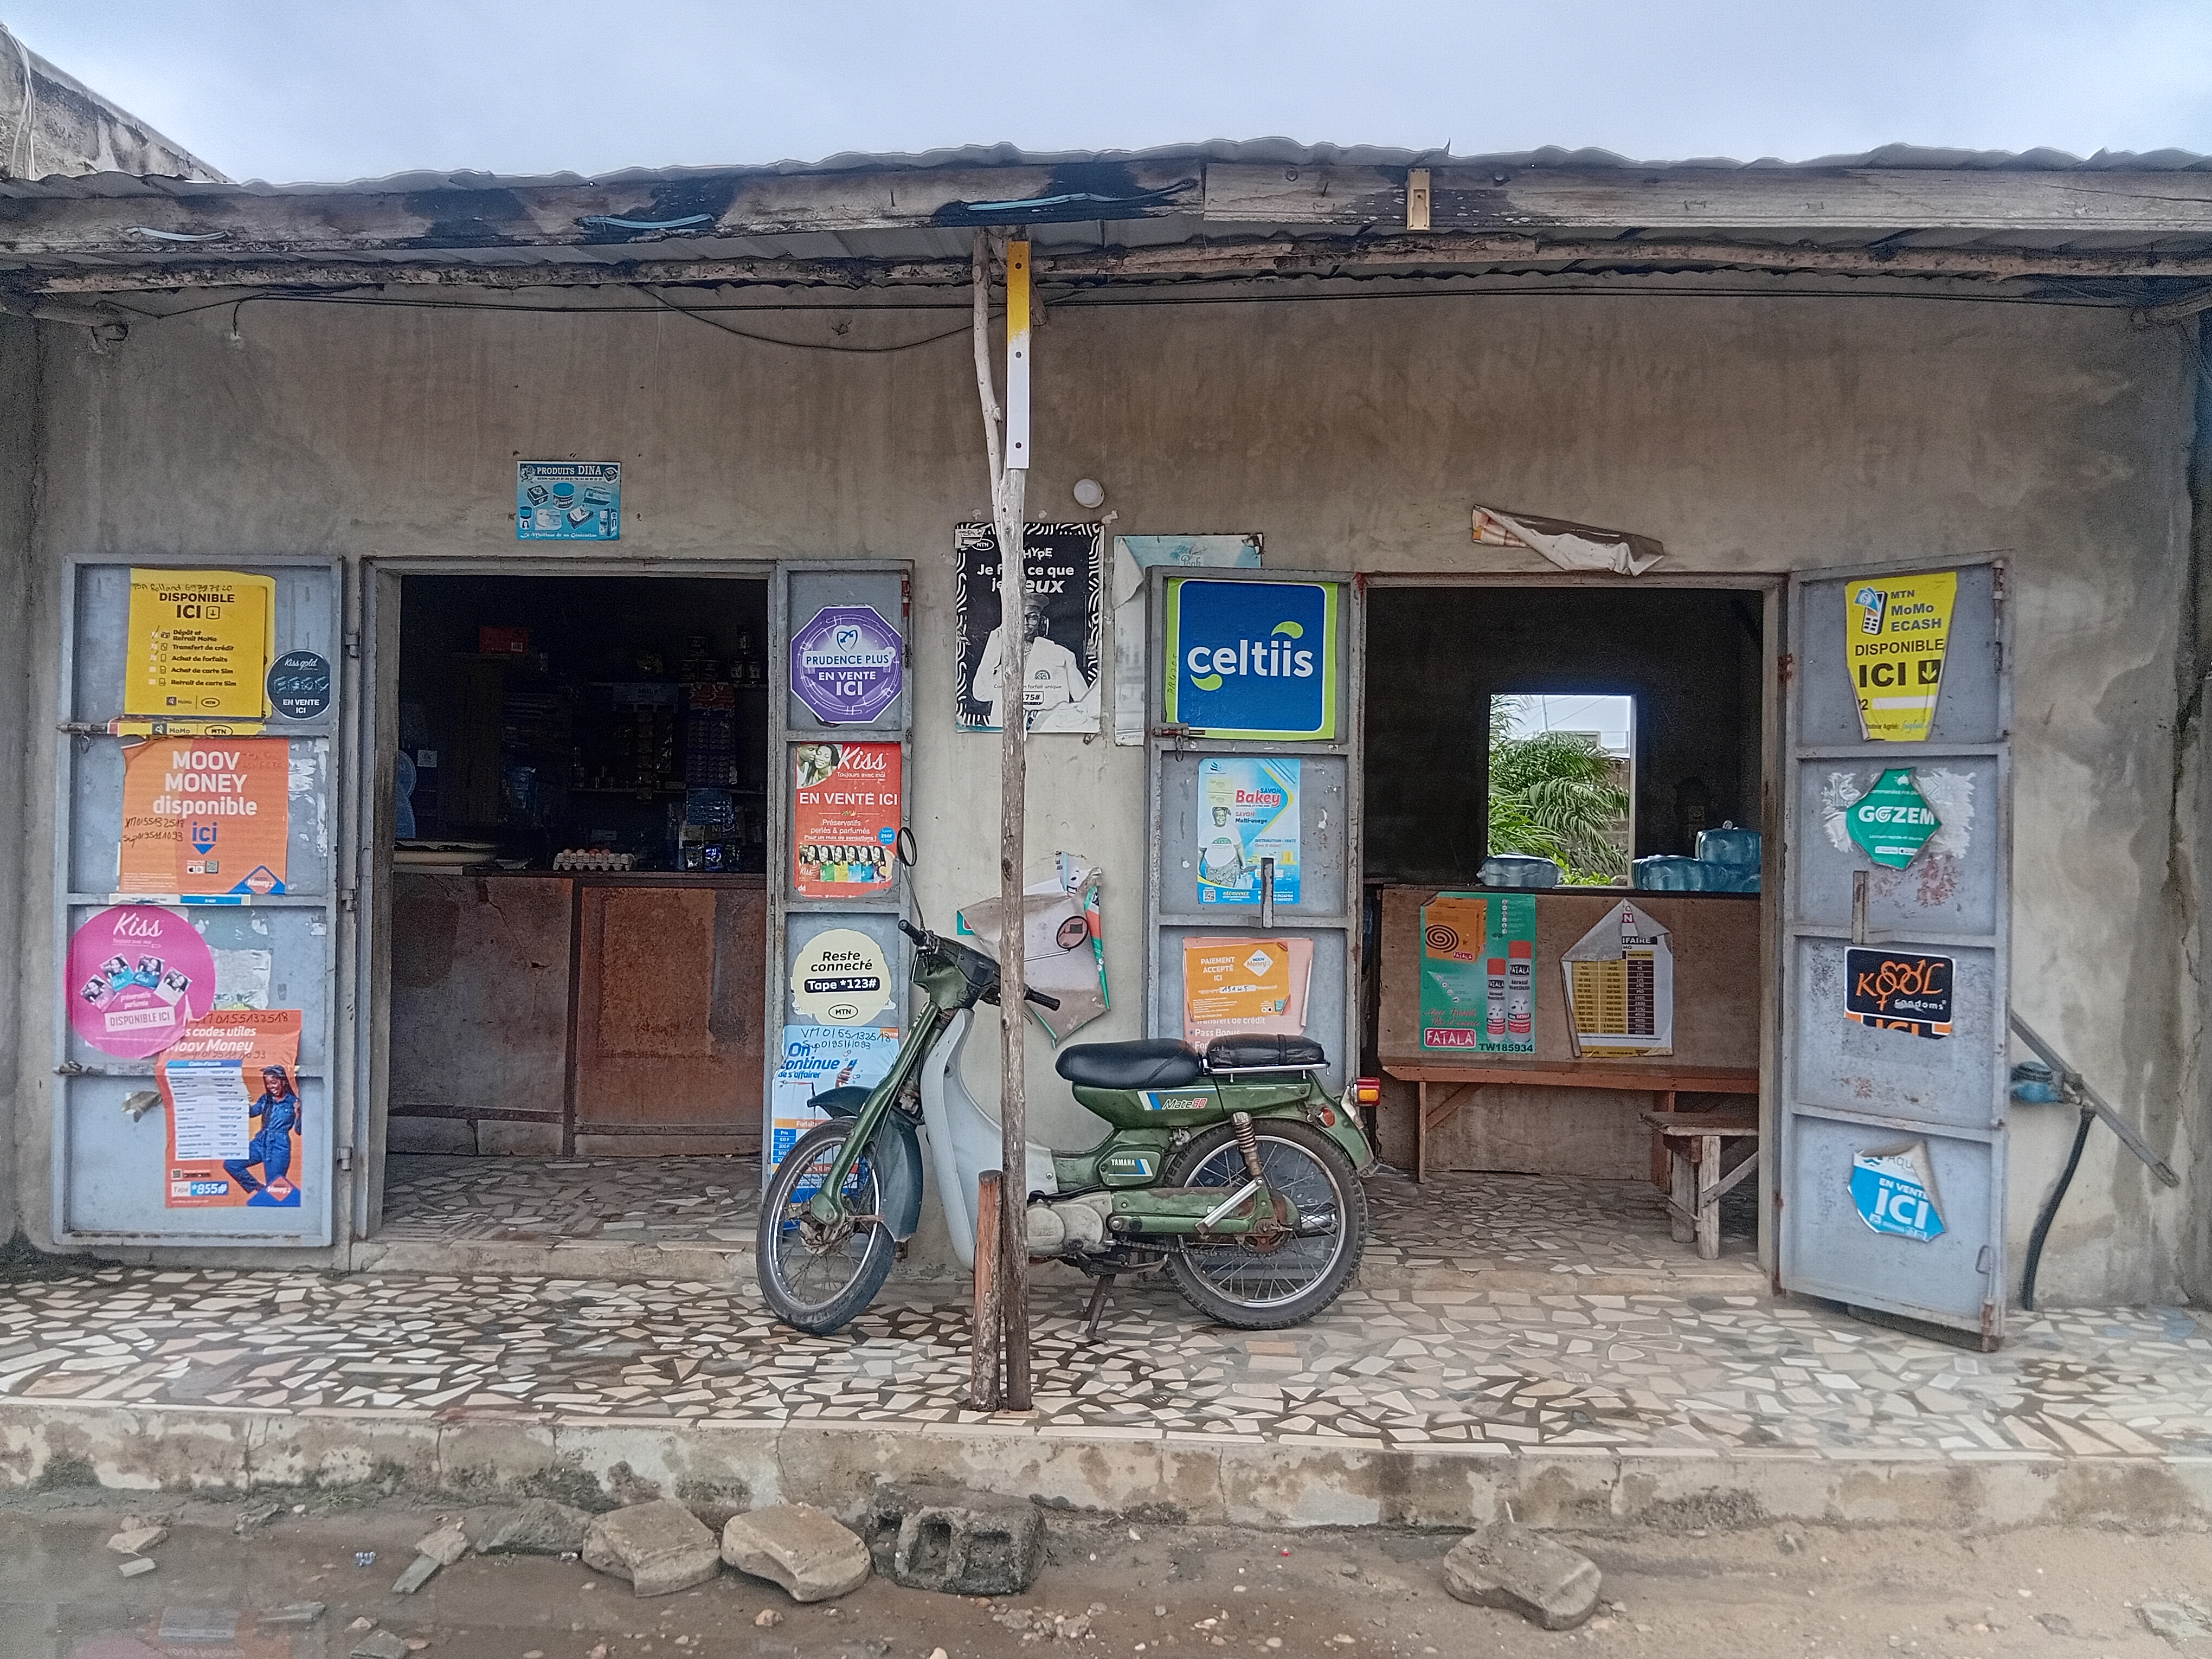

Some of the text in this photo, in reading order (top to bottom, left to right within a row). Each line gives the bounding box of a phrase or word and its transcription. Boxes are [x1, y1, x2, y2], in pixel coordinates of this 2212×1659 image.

[537, 466, 602, 475] PRODUITS DINA
[1023, 547, 1053, 560] HYPE
[977, 564, 993, 575] Je
[1027, 567, 1044, 575] ce
[1047, 567, 1074, 578] que
[1026, 580, 1065, 593] eux
[159, 593, 235, 602] DISPONIBLE
[1891, 590, 1915, 599] MTN
[177, 605, 201, 619] ICI
[1891, 604, 1934, 616] MoMo
[1891, 618, 1941, 632] ECASH
[1855, 639, 1945, 656] DISPONIBLE
[284, 658, 318, 670] Kiss gold
[806, 655, 889, 665] PRUDENCE PLUS
[1187, 640, 1313, 677] celtiis
[819, 671, 876, 680] EN VENTE
[1859, 662, 1906, 688] ICI
[836, 681, 863, 696] ICI
[172, 751, 241, 770] MOOV
[838, 747, 887, 770] Kiss
[165, 774, 247, 793] MONEY
[800, 793, 897, 805] EN VENTE ICI
[1236, 789, 1281, 807] Bakey
[153, 795, 258, 819] disponible
[1859, 806, 1934, 825] GOZEM
[192, 821, 217, 841] ici
[113, 912, 163, 937] Kiss
[822, 951, 860, 961] Reste
[1200, 956, 1235, 965] PAIEMENT
[1453, 951, 1472, 960] FATALA
[811, 959, 872, 972] connecté
[1203, 964, 1234, 973] ACCEPTÉ
[1510, 966, 1529, 974] FATALA
[807, 980, 837, 991] Tape
[1856, 959, 1945, 1011] KOOL
[110, 1012, 170, 1026] DISPONIBLE ICI
[192, 1027, 225, 1037] codes
[227, 1026, 256, 1037] utiles
[1195, 1028, 1214, 1037] Pass
[1427, 1030, 1473, 1045] FATALA
[206, 1039, 254, 1054] Money
[789, 1042, 811, 1057] On
[1478, 1043, 1533, 1052] TW185934
[789, 1070, 821, 1079] s'affairer
[1879, 1178, 1894, 1188] EN
[1875, 1187, 1928, 1230] ICI
